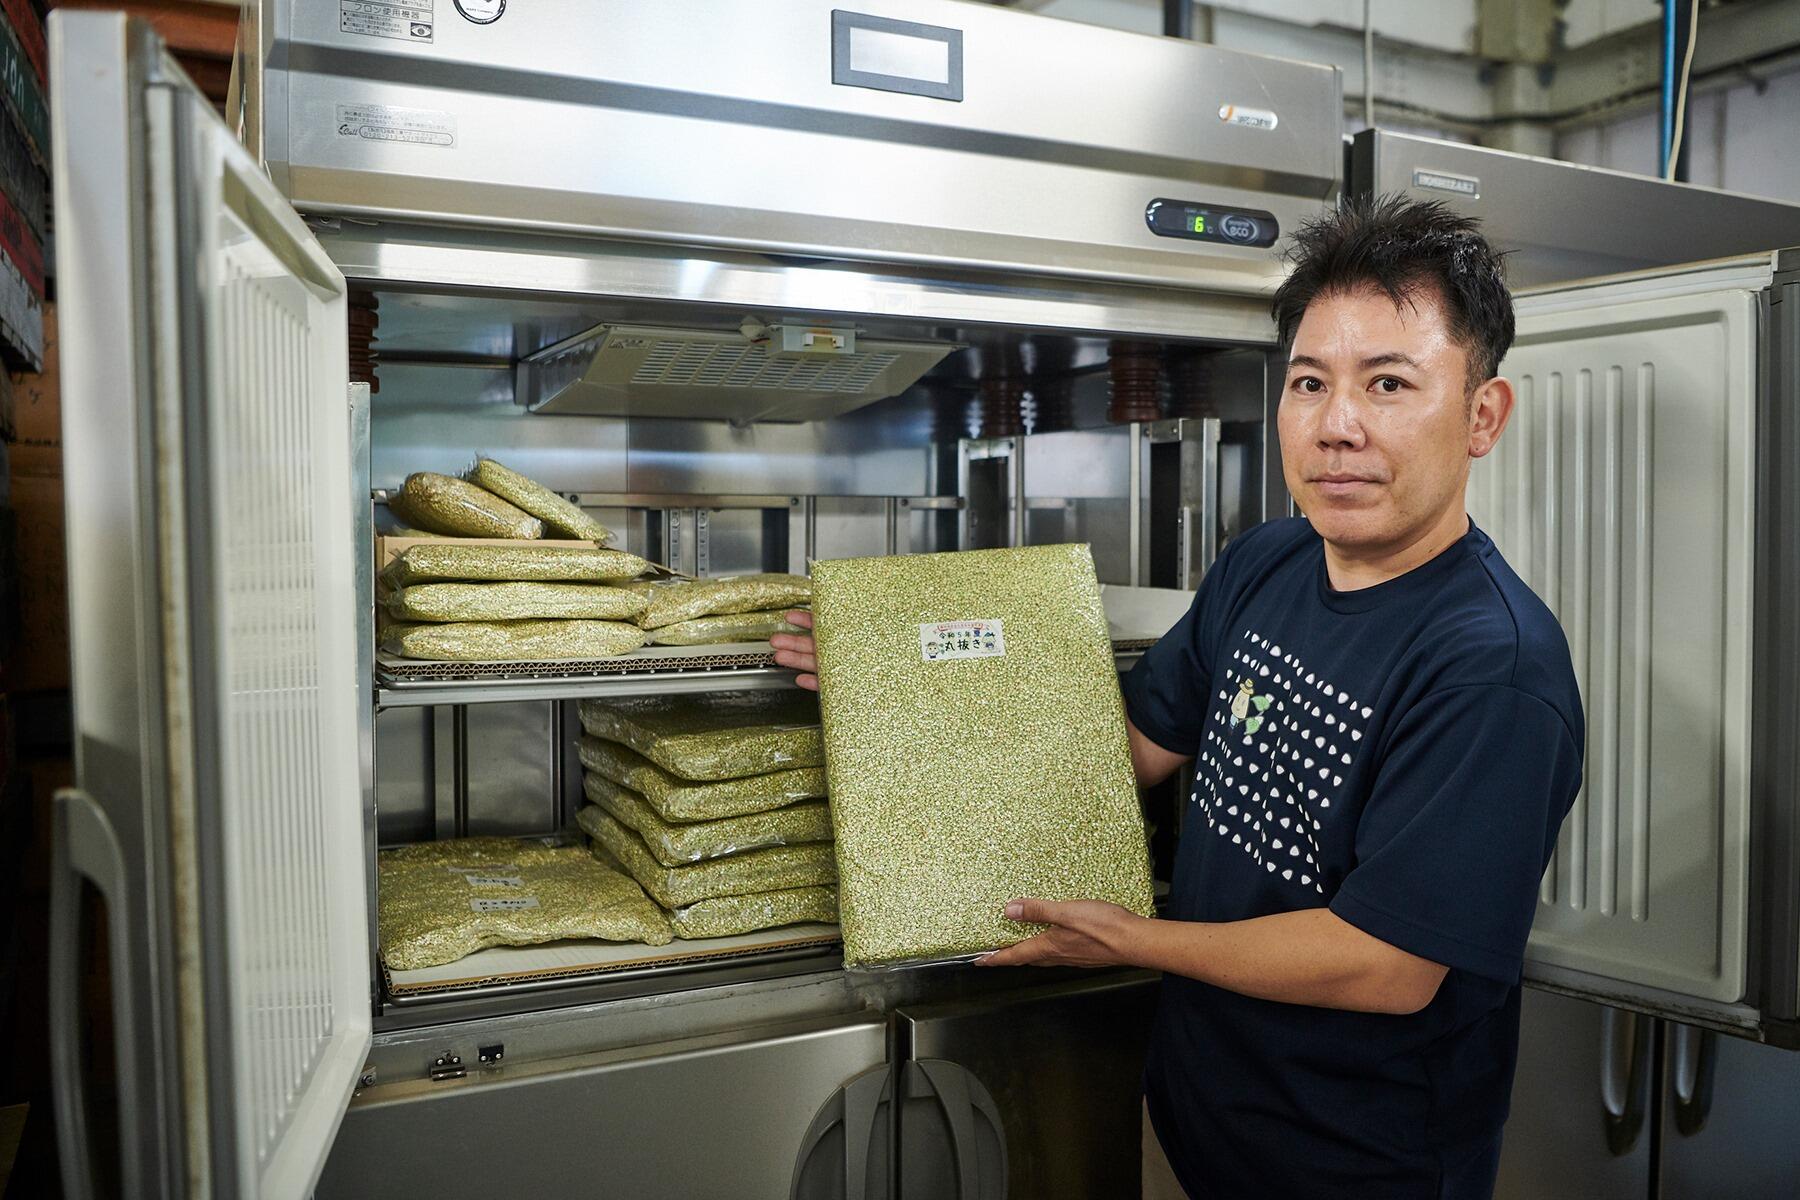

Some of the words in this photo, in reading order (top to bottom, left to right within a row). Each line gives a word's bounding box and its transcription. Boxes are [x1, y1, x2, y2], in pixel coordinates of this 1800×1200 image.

[354, 3, 419, 19] フロン使用機器
[1194, 216, 1204, 233] 6
[1229, 226, 1249, 238] eco
[944, 639, 980, 652] 丸抜き
